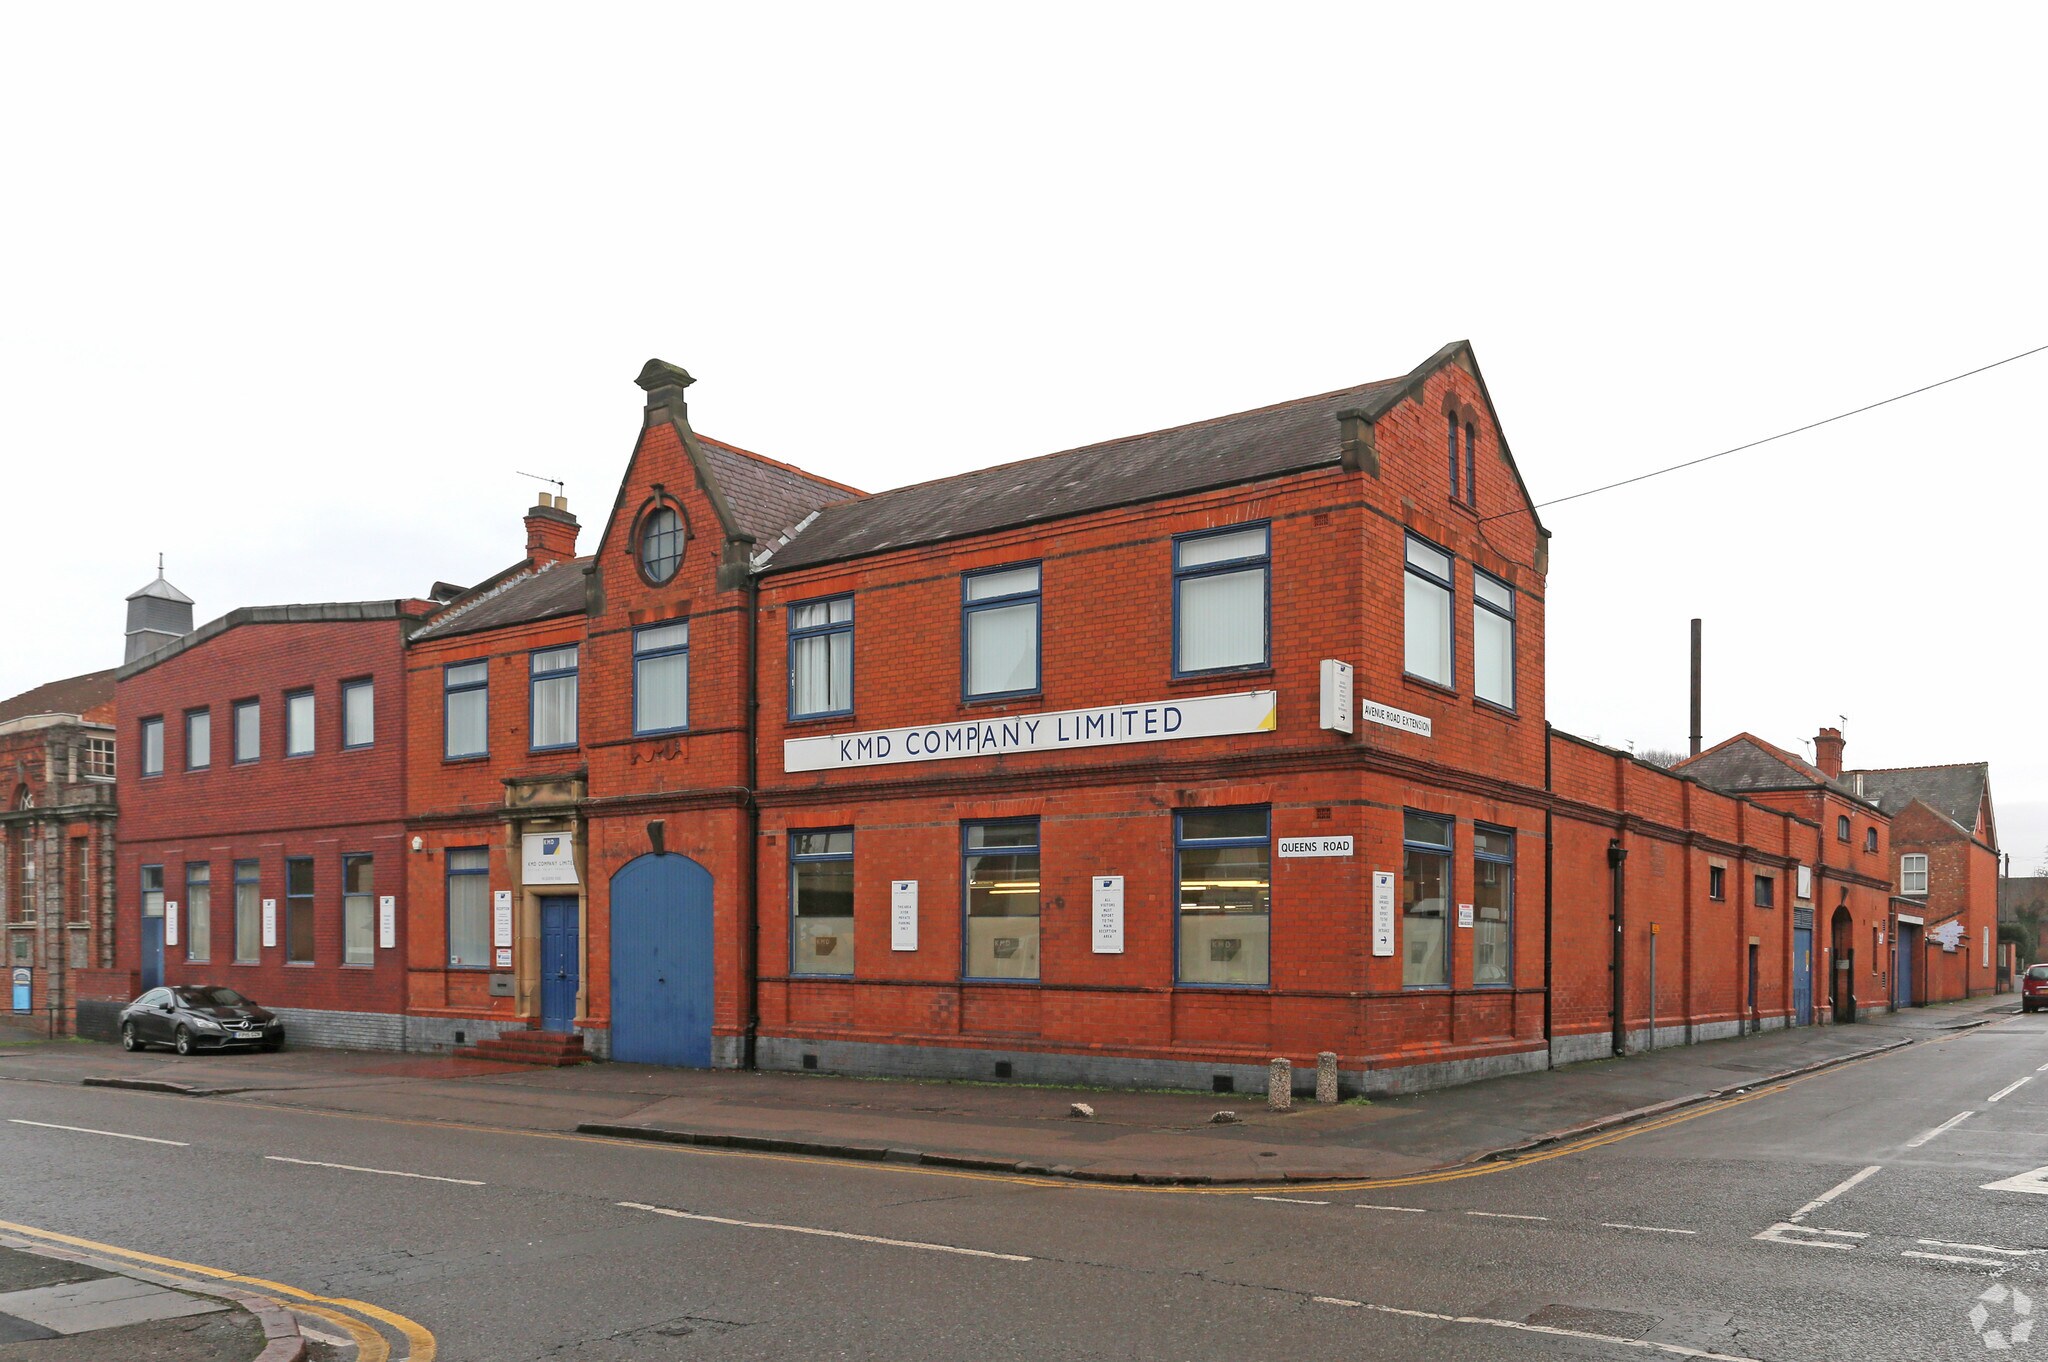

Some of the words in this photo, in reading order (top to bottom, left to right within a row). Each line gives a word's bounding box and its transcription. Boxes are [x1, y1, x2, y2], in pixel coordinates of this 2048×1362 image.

[1365, 705, 1385, 719] AVENUE
[1387, 711, 1400, 723] ROAD
[1403, 716, 1429, 731] EXTENSION
[841, 736, 890, 761] KMD
[906, 720, 1040, 755] COMPANY
[1058, 707, 1182, 741] LIMITED
[1281, 842, 1317, 852] QUEENS
[1323, 841, 1350, 851] ROAD
